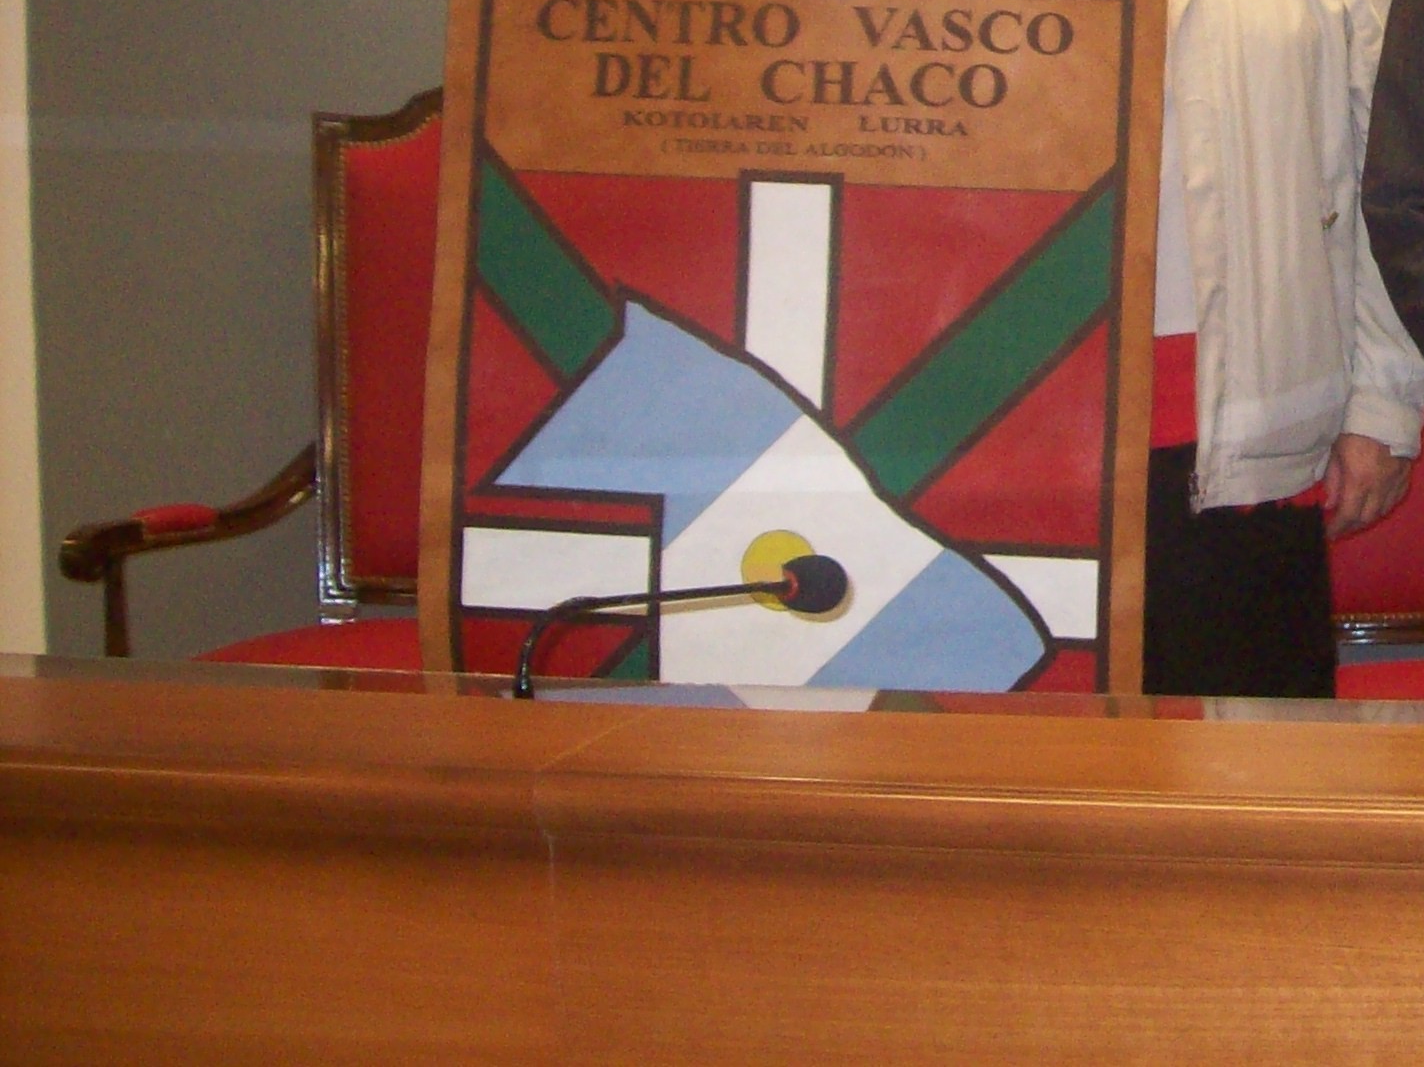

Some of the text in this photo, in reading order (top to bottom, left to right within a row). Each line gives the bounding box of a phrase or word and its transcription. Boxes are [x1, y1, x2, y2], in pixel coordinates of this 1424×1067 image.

[853, 6, 1074, 55] VASCO
[590, 52, 1008, 108] DEL CHACO
[859, 114, 968, 136] LURRA
[755, 140, 798, 156] DEL
